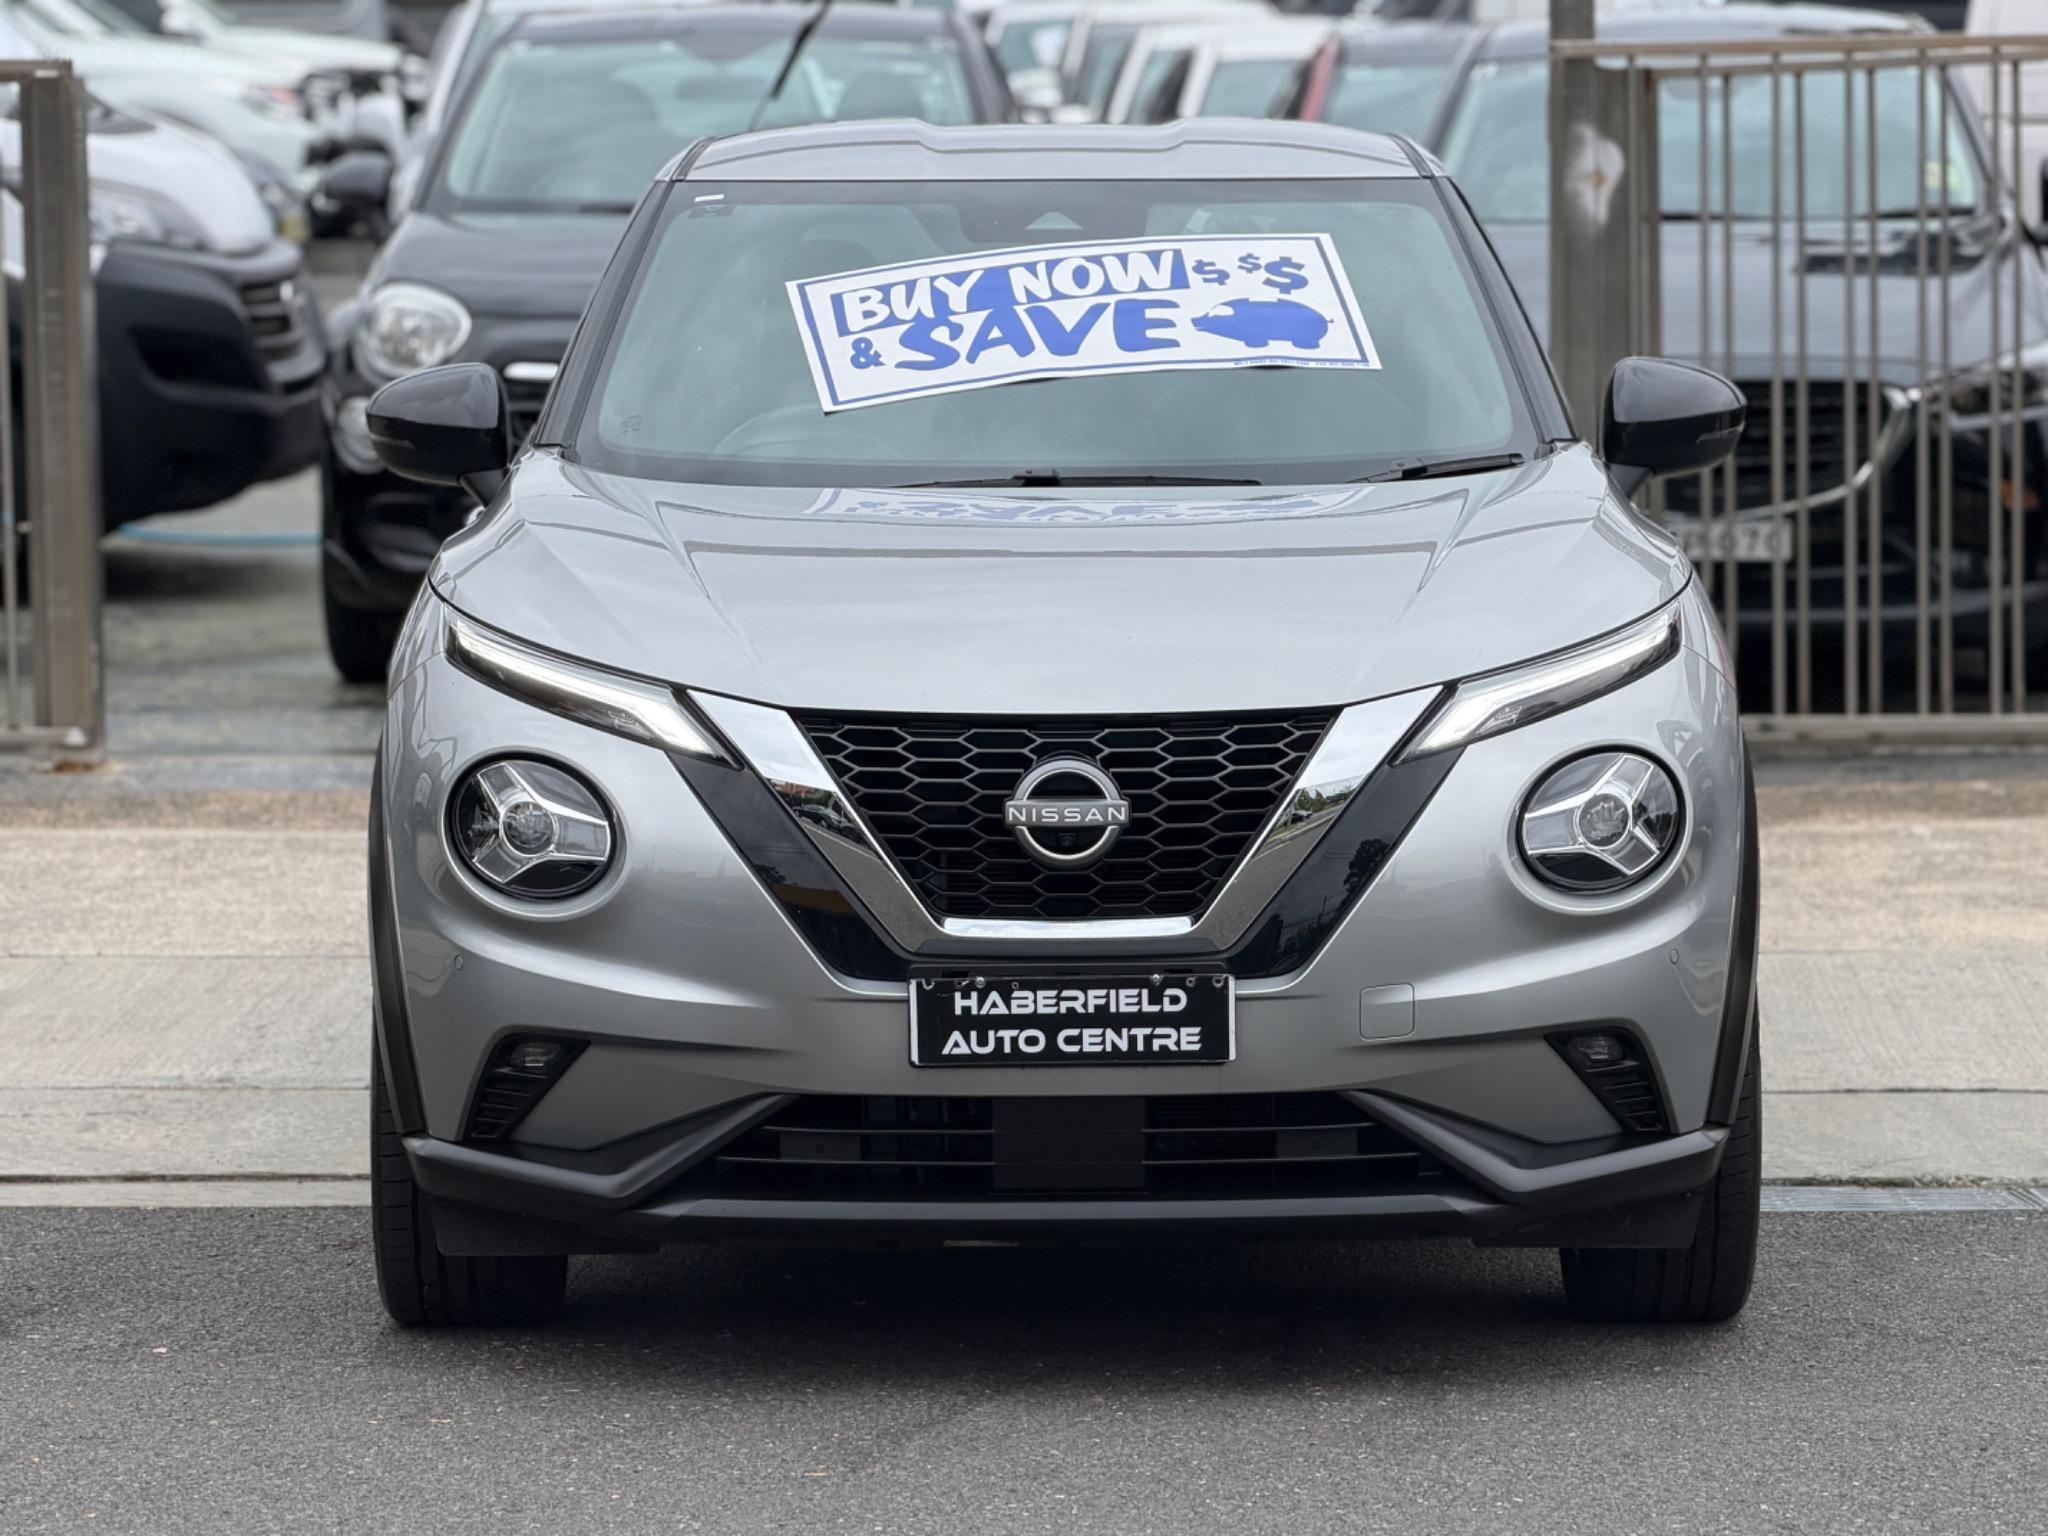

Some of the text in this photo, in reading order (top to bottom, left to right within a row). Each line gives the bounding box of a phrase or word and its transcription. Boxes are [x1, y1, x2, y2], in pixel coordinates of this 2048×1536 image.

[843, 270, 984, 332] BUY
[1009, 251, 1176, 304] NOW
[849, 298, 1181, 372] & SAVE
[1008, 806, 1127, 823] NISSAN
[953, 987, 1188, 1016] HABERFIELD
[940, 1026, 1203, 1055] AUTO CENTRE
